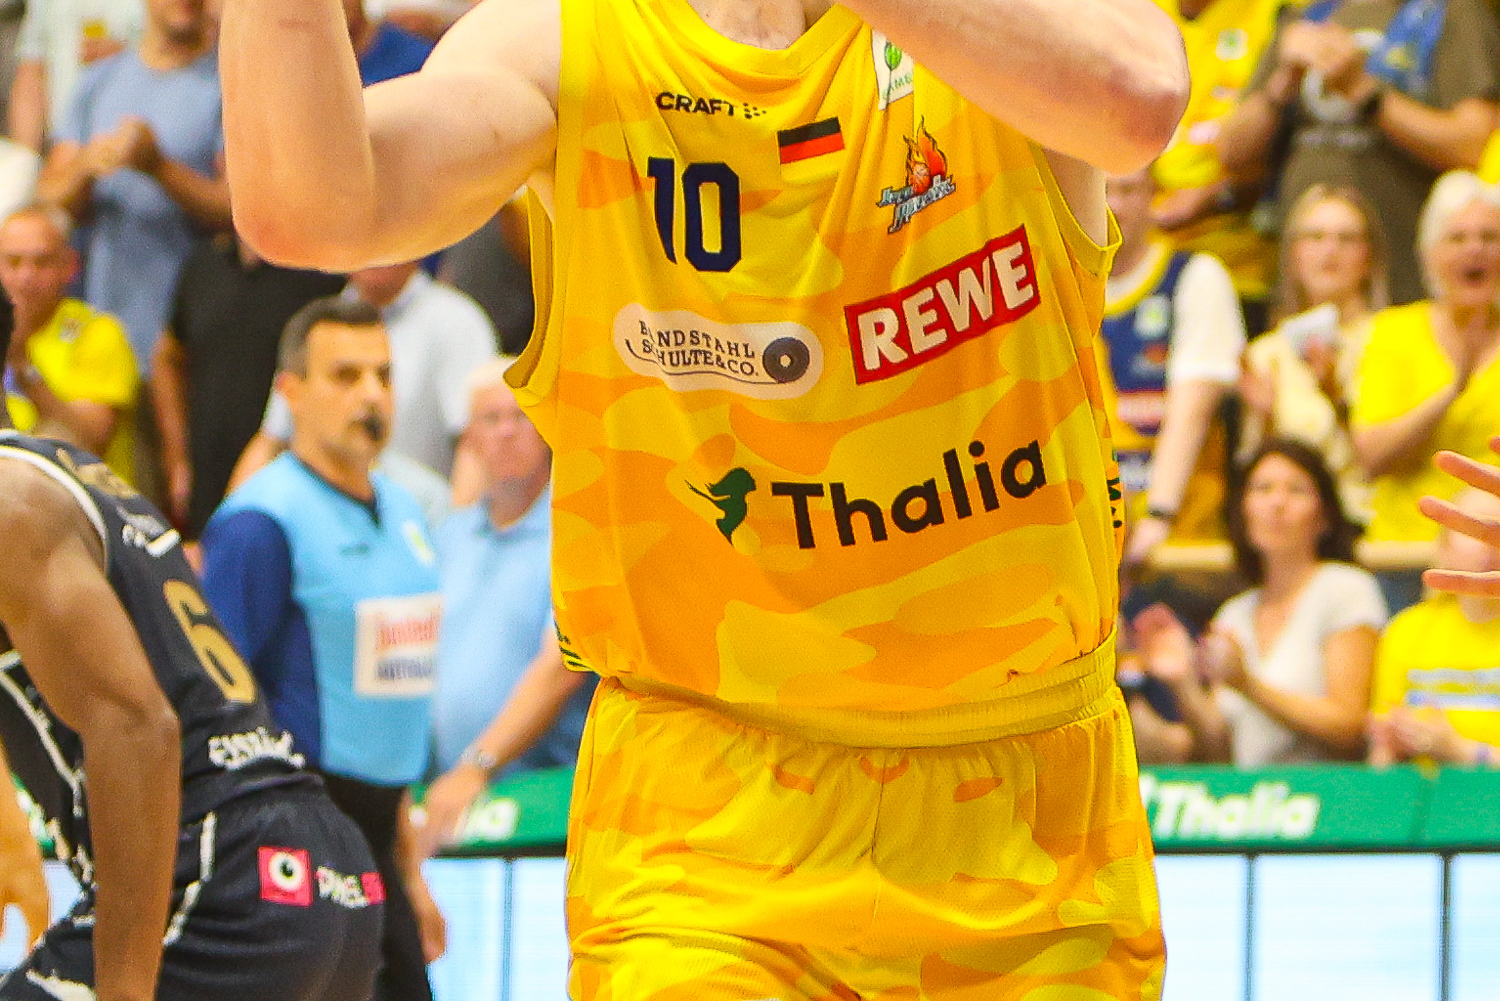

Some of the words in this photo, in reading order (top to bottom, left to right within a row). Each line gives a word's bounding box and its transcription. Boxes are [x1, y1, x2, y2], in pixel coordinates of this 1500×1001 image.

[655, 91, 735, 117] CRAFT
[646, 155, 742, 273] 10
[857, 241, 1035, 372] REWE
[771, 440, 1047, 549] Thalia
[163, 579, 256, 703] 6
[1154, 779, 1320, 839] Thalia
